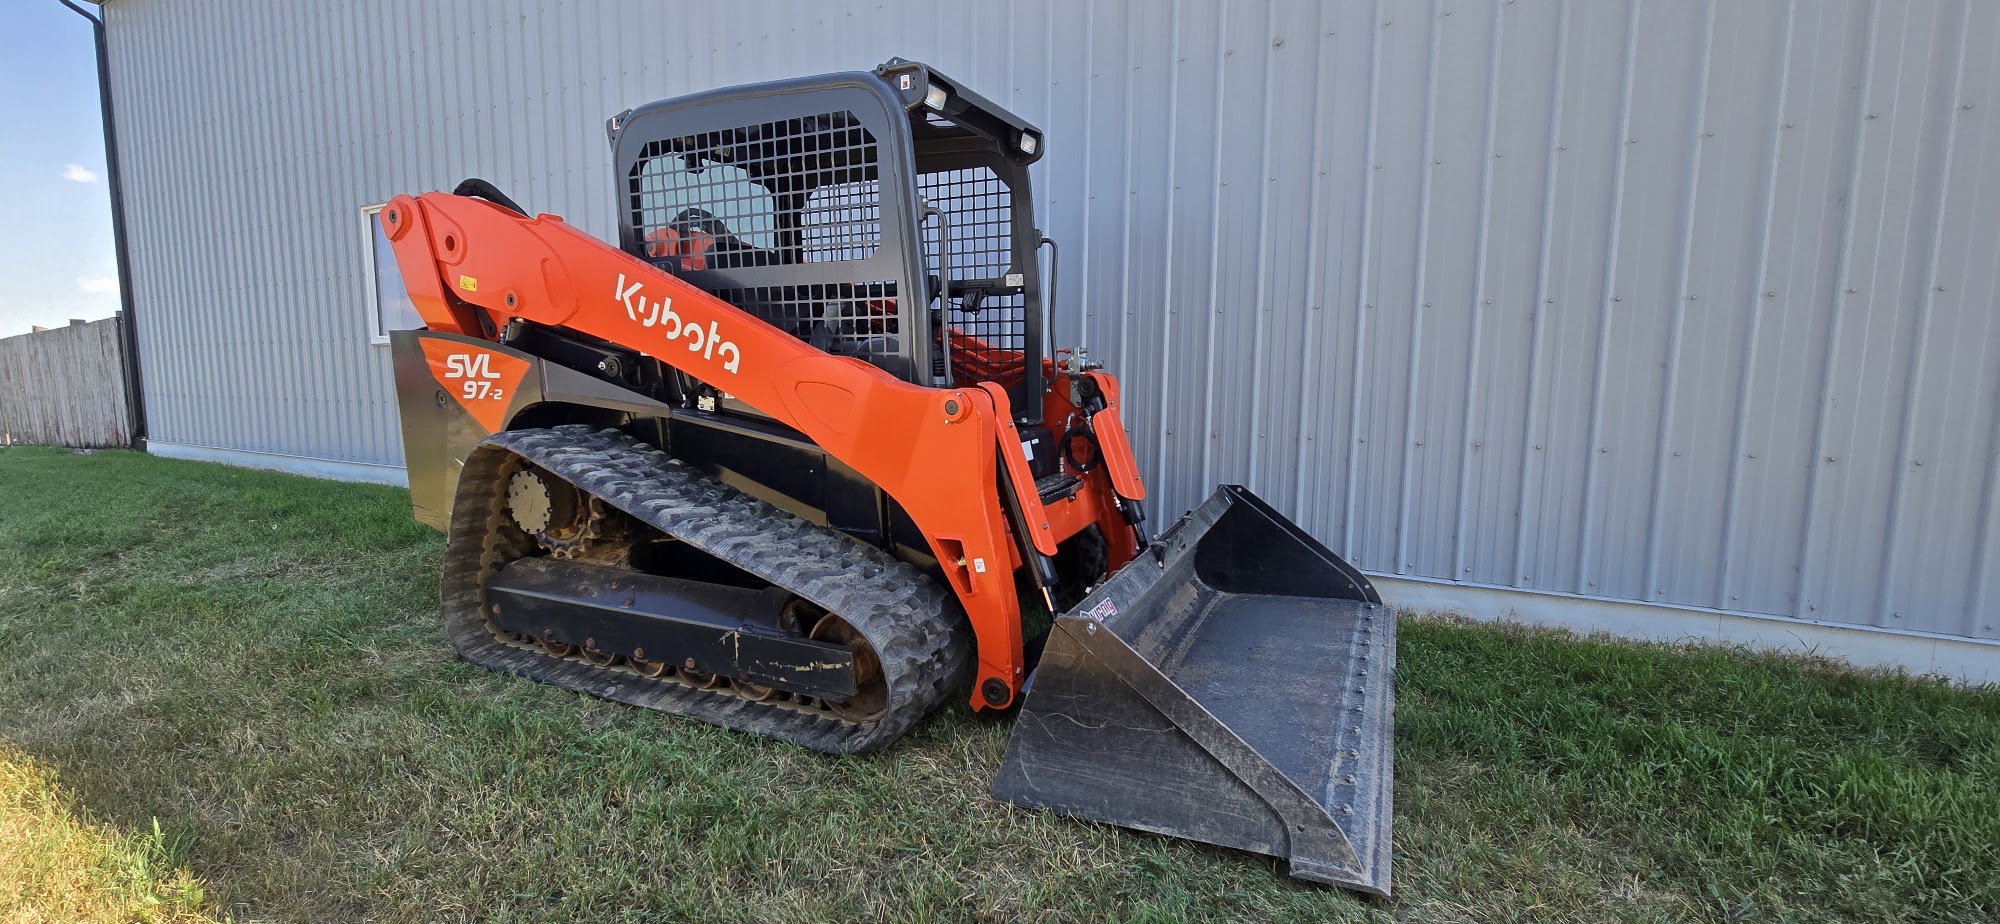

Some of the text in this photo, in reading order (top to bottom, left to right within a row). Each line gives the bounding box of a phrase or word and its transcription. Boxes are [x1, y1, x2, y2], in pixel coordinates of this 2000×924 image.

[615, 273, 740, 374] Kubota
[445, 354, 500, 378] SVL
[463, 381, 503, 400] 97-2
